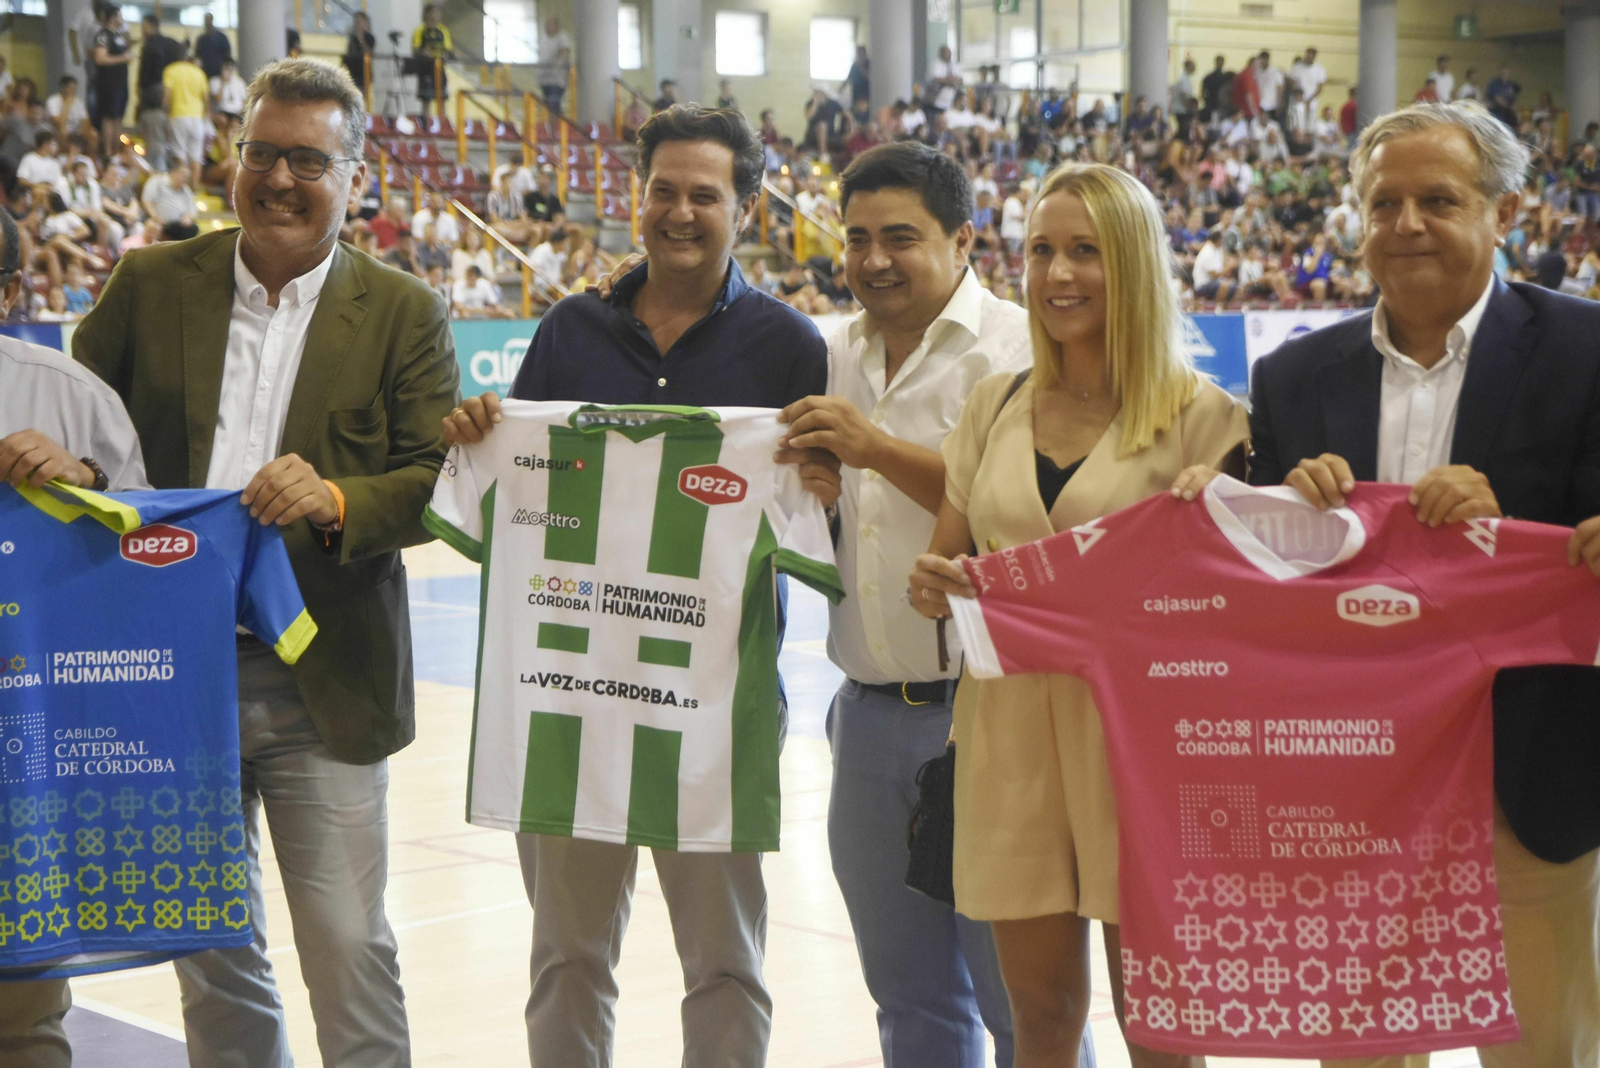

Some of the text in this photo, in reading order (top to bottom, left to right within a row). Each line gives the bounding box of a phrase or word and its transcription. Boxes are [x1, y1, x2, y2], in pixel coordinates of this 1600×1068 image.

[514, 454, 572, 471] cajasur
[511, 508, 581, 530] Mosttro
[528, 592, 591, 612] CÓRDOBA
[603, 584, 697, 609] PATRIMONIO
[1143, 595, 1209, 615] cajasur
[601, 598, 706, 628] HUMANIDAD
[53, 649, 160, 667] PATRIMONIO
[53, 664, 175, 685] HUMANIDAD
[1147, 659, 1229, 677] Mosttro
[54, 727, 117, 741] CABILDO
[1264, 719, 1380, 736] PATRIMONIO
[54, 740, 149, 758] CATEDRAL
[1176, 740, 1251, 756] CÓRDOBA
[1264, 737, 1396, 756] HUMANIDAD
[55, 756, 177, 777] DE CÓRDOBA
[1266, 806, 1335, 819] CABILDO
[1267, 821, 1371, 839] CATEDRAL
[1270, 837, 1403, 859] DE CÓRDOBA
